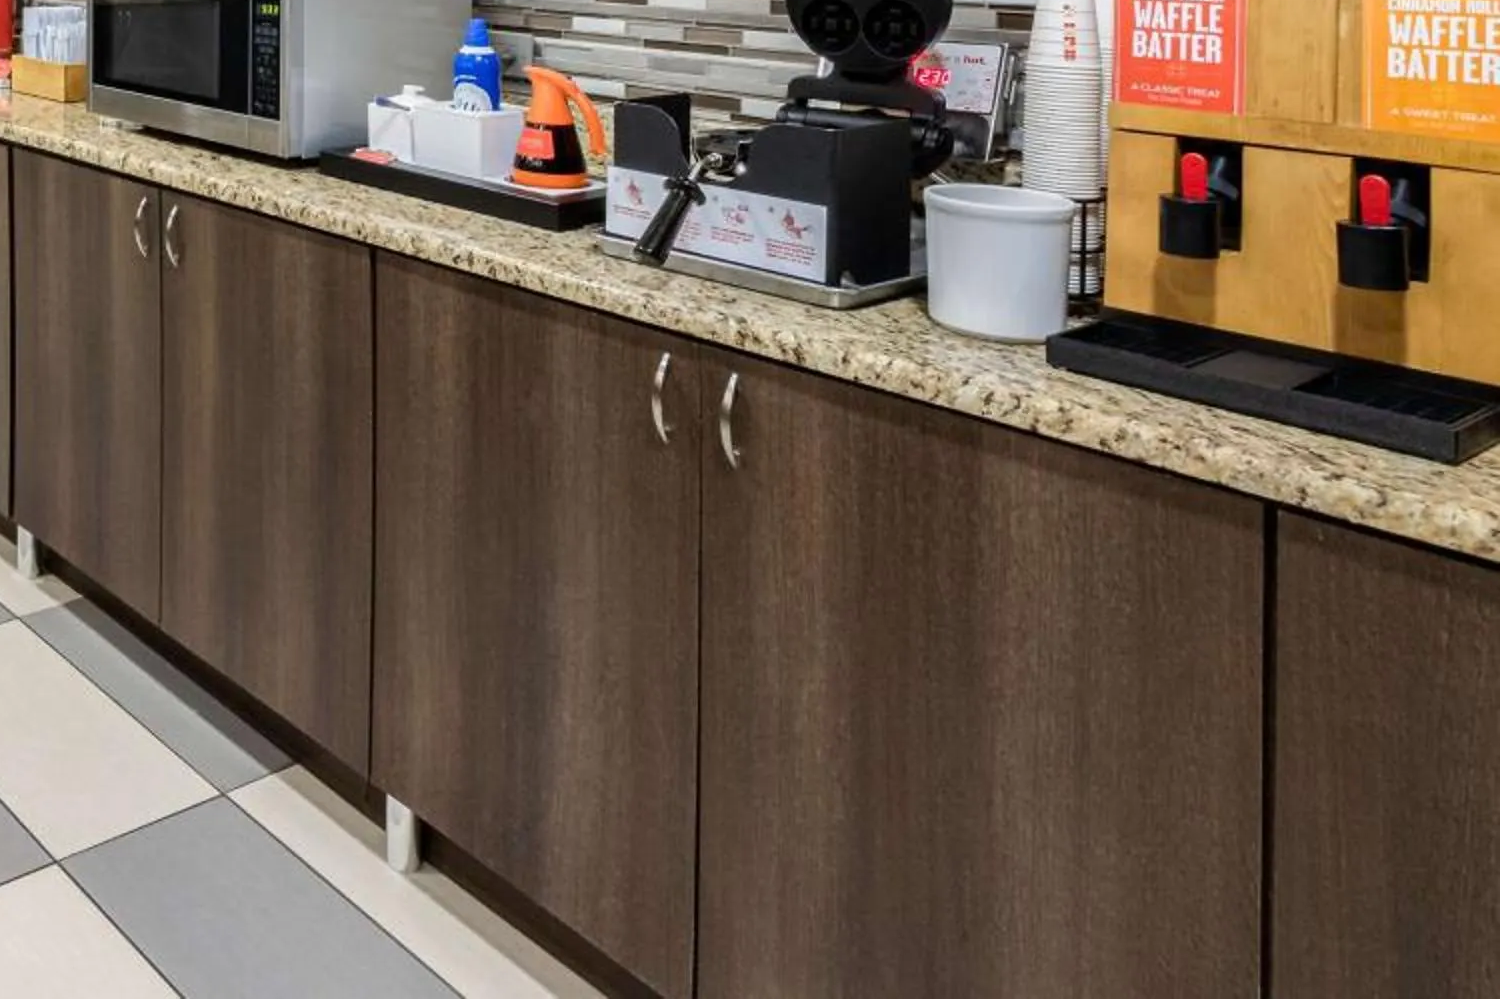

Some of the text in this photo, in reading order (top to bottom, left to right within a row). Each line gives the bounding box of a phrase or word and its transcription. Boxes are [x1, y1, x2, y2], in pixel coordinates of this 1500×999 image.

[1133, 0, 1224, 33] WAFFLE
[1388, 13, 1500, 50] WAFFLE
[1132, 30, 1222, 64] BATTER
[1387, 46, 1500, 85] BATTER
[1187, 86, 1221, 99] TREAT
